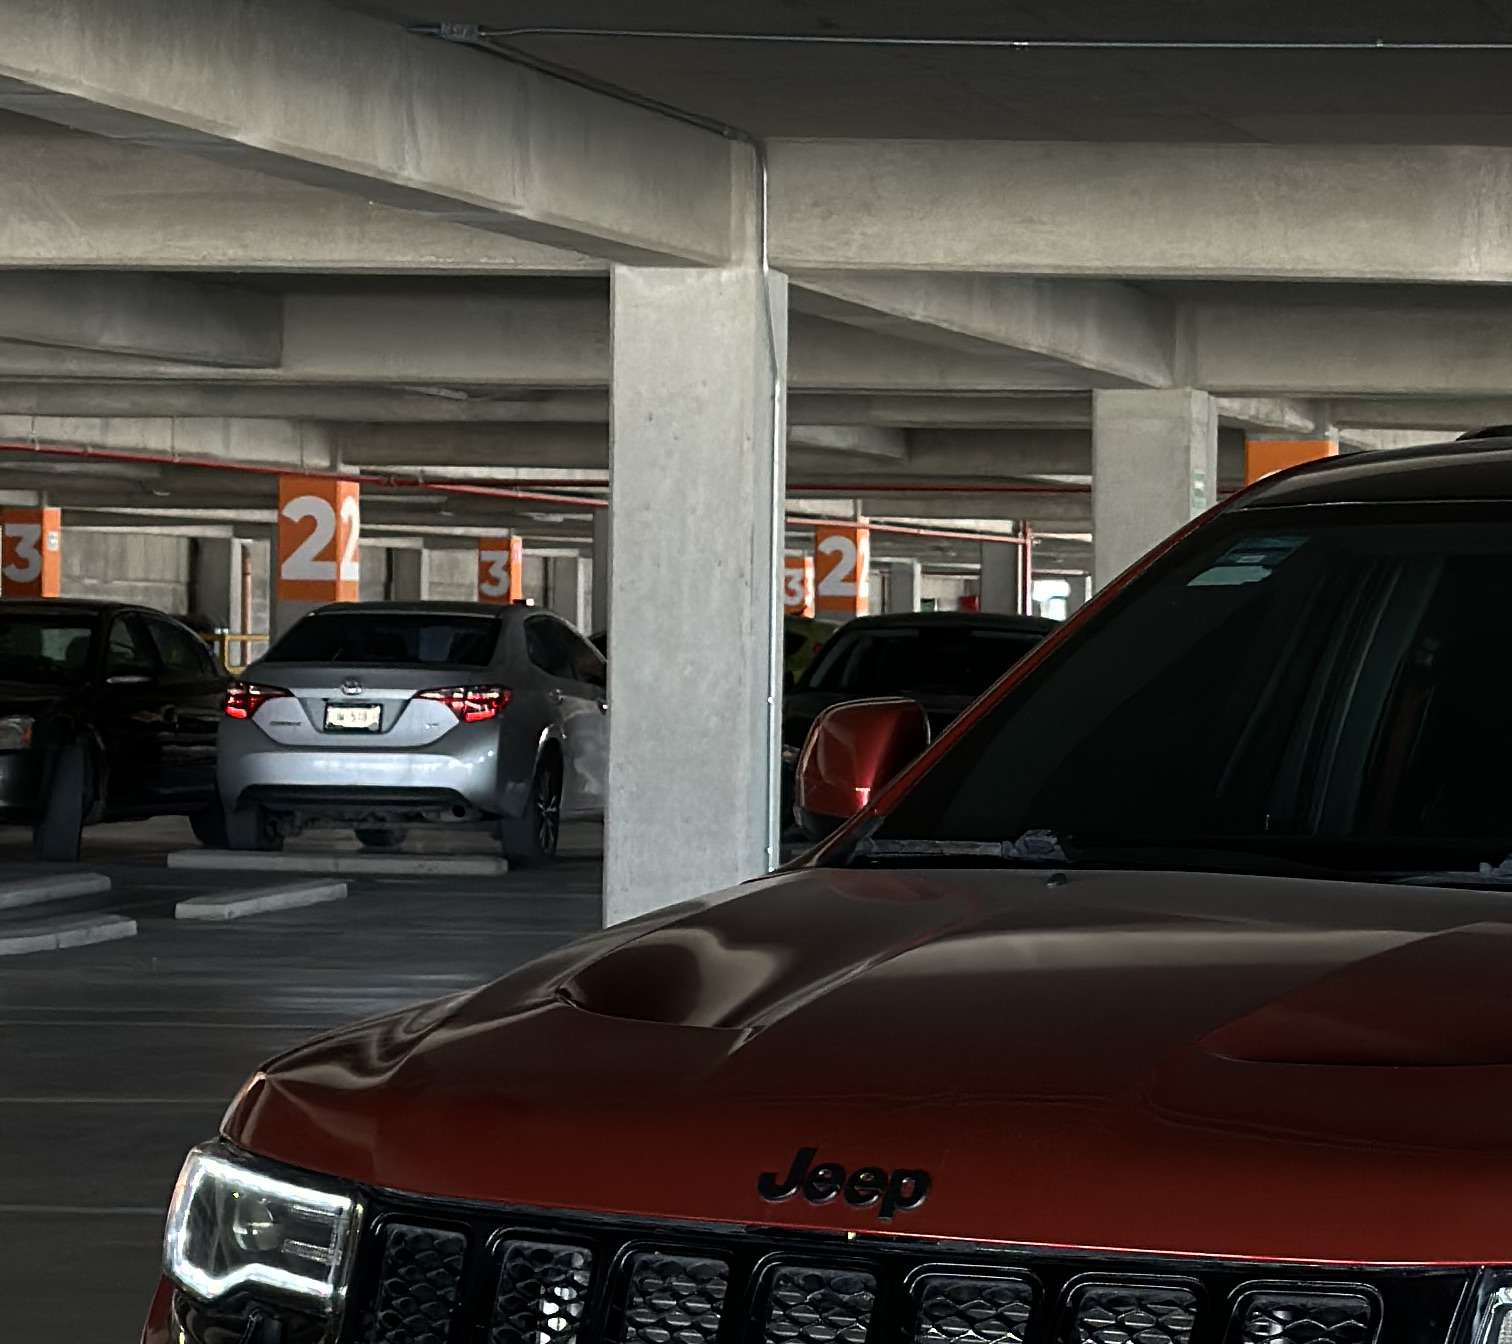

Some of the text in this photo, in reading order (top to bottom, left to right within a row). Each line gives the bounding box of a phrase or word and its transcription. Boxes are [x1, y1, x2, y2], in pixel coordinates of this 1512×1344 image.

[4, 524, 42, 582] 3
[281, 495, 337, 581] 2
[340, 497, 360, 582] 2
[817, 536, 857, 596] 2
[480, 550, 509, 596] 3
[757, 1147, 932, 1221] Jeep
